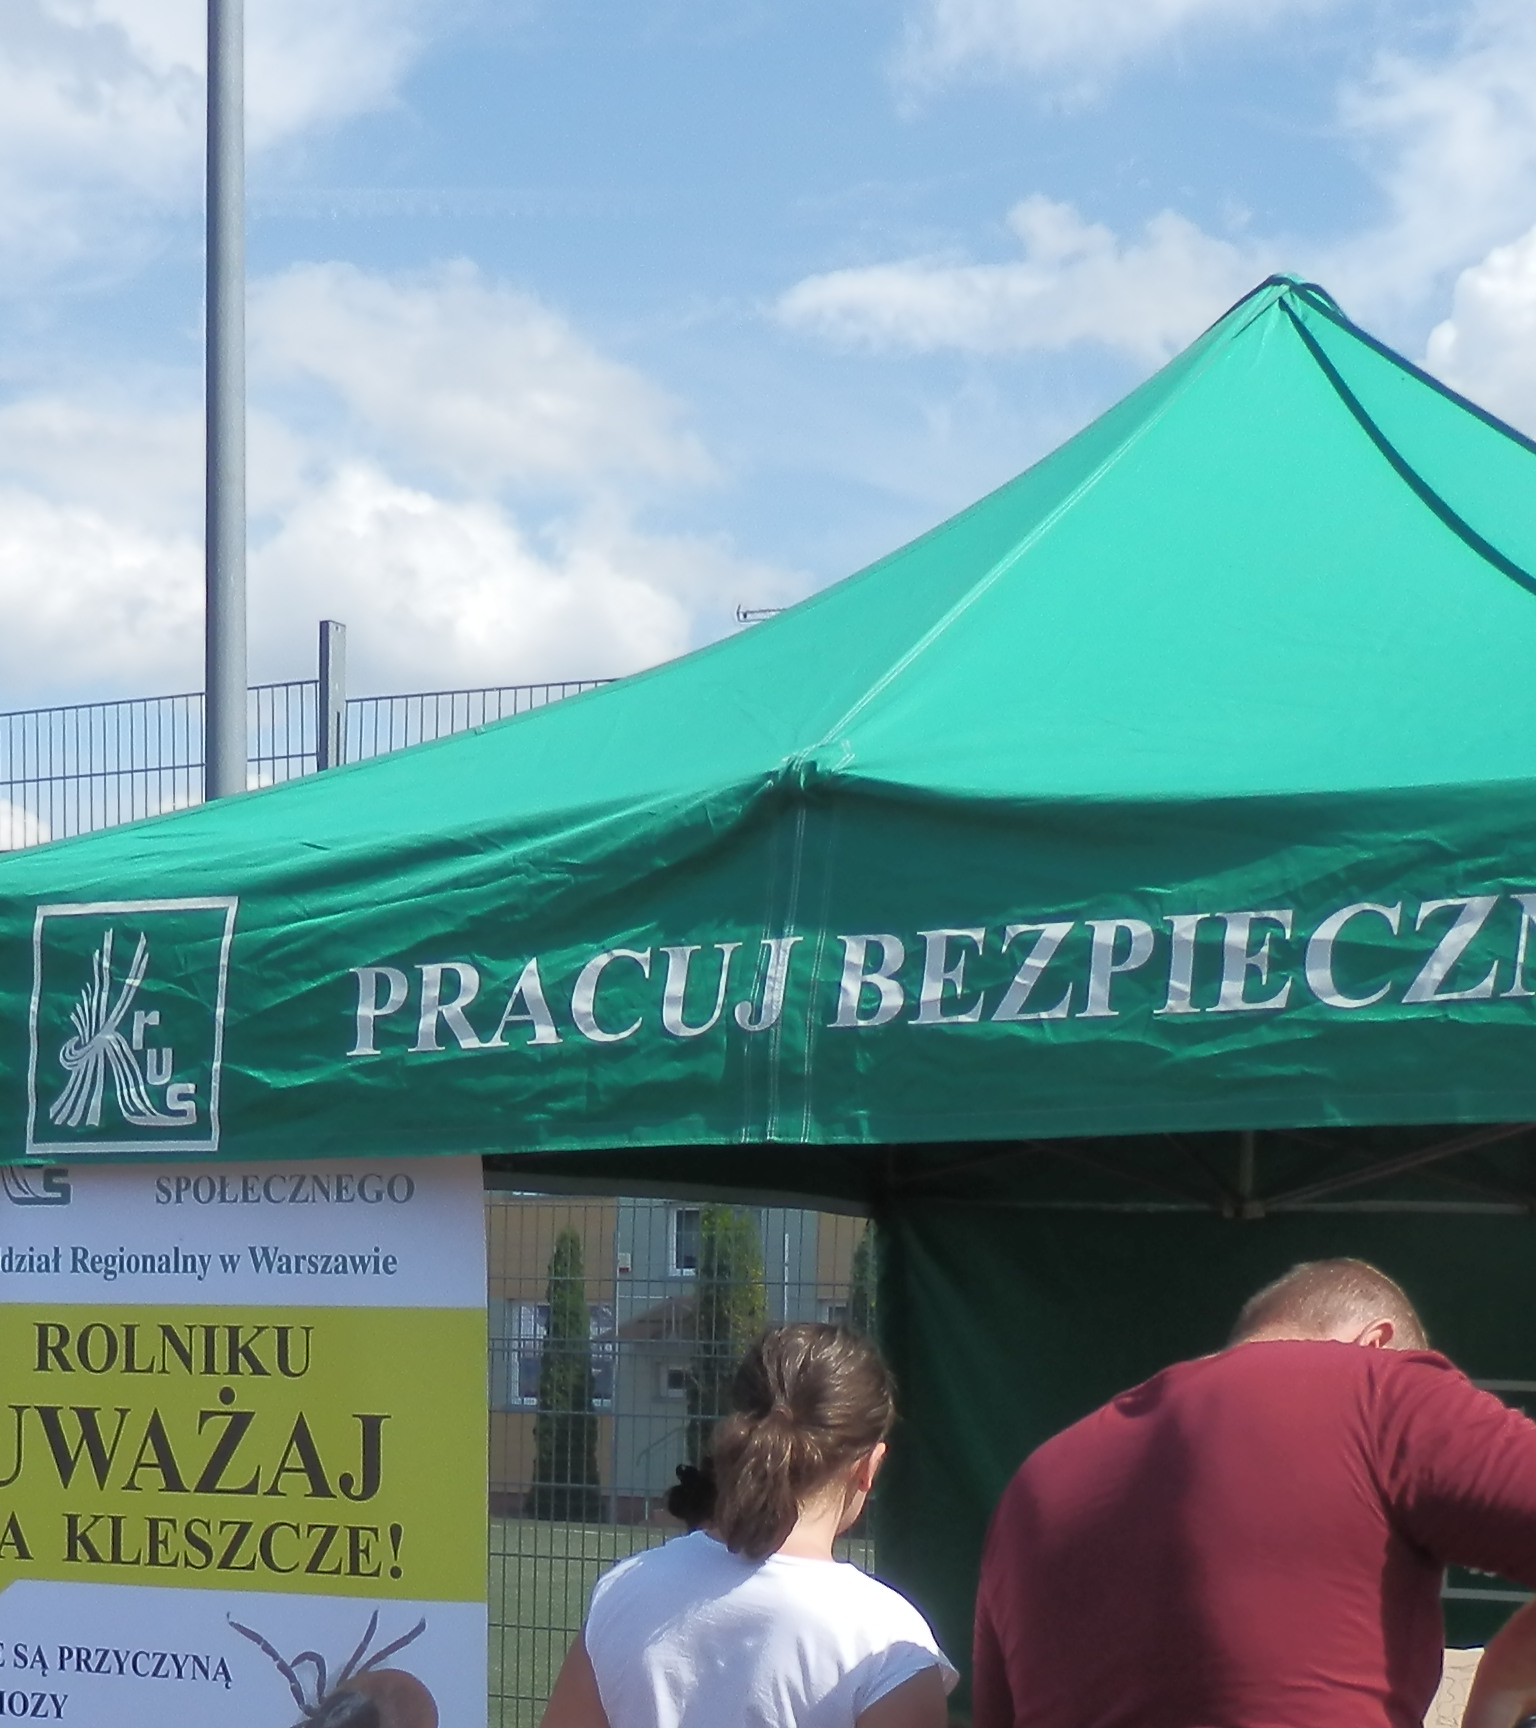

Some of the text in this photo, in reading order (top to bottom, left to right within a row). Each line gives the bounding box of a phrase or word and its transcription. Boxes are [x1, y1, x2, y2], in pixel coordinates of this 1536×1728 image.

[347, 935, 803, 1058] PRACUJ
[155, 1172, 416, 1206] SPOŁECZNEGO
[70, 1246, 211, 1281] Regionalny
[220, 1254, 241, 1274] w
[248, 1246, 398, 1276] Warszawie
[33, 1322, 314, 1378] ROLNIKU
[62, 1513, 404, 1580] KLESZCZE!
[14, 1642, 49, 1678] SĄ
[57, 1645, 233, 1690] PRZYCZYNĄ
